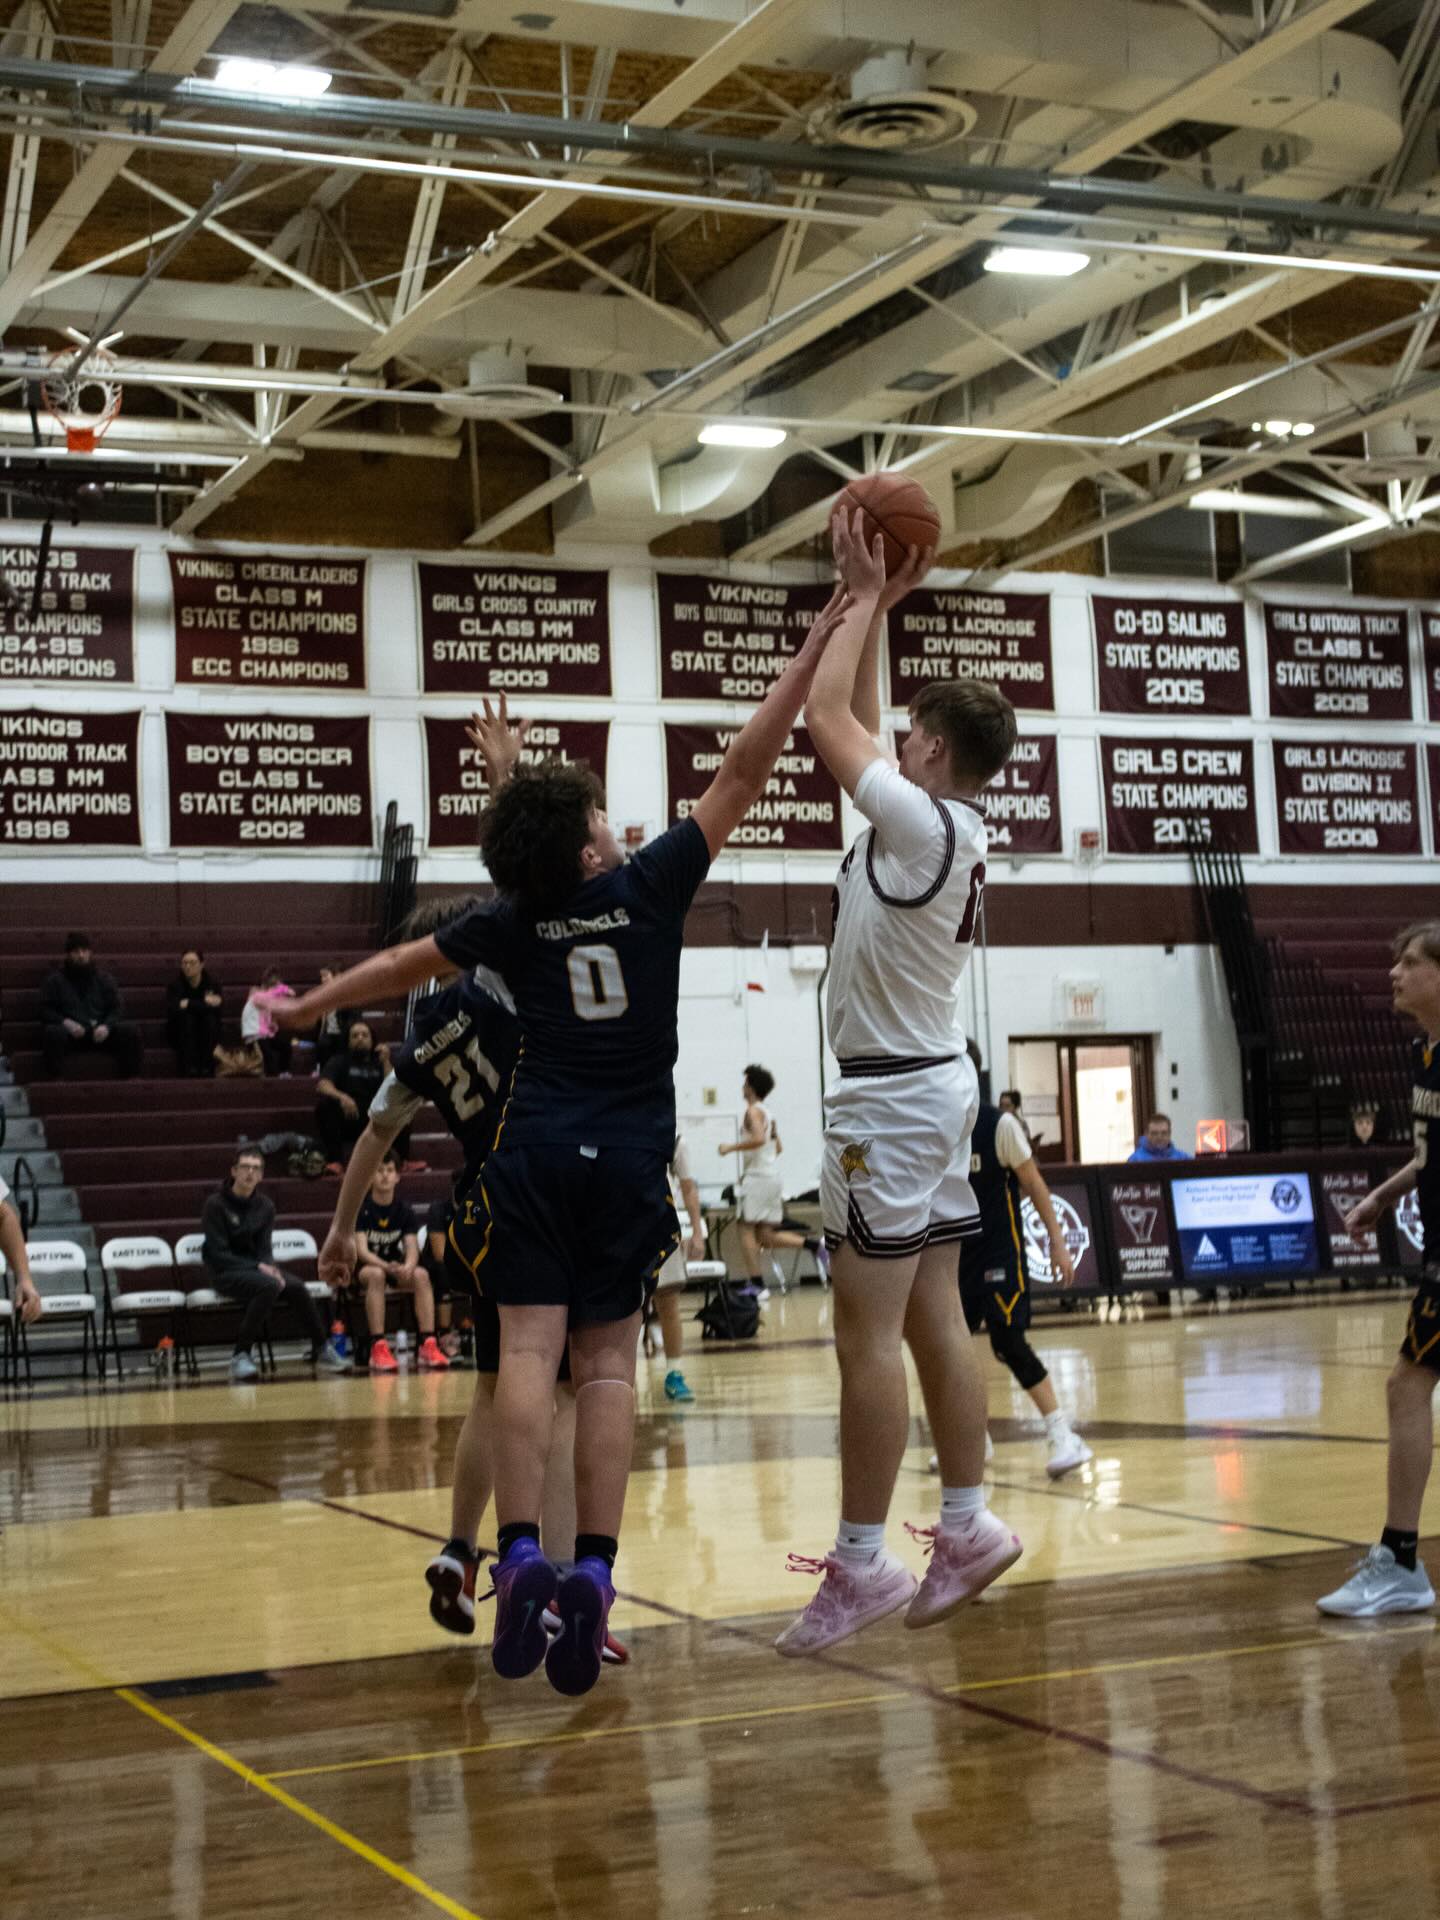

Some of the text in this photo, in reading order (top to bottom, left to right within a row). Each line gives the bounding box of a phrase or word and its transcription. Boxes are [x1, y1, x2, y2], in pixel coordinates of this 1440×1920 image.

[0, 549, 77, 569] KINGS
[59, 572, 111, 591] TRACK
[176, 560, 357, 585] VIKINGS CHEERLEADERS
[474, 574, 557, 593] VIKINGS
[215, 585, 323, 607] CLASS M
[708, 584, 789, 605] VIKINGS
[934, 596, 1005, 614] VIKINGS
[432, 595, 597, 616] GIRLS CROSS COUNTRY
[674, 604, 700, 621] BOYS
[705, 605, 748, 624] OUTDOOR
[752, 609, 784, 627] TRACK
[181, 608, 357, 634] STATE CHAMPIONS
[460, 618, 573, 638] CLASS MM
[904, 615, 1036, 637] BOYS LACROSSE
[1114, 609, 1226, 637] CO-ED SAILING
[1273, 611, 1400, 635] GIRLS OUTDOOR TRACK
[0, 636, 84, 655] 94-95
[703, 631, 795, 652] CLASS L
[924, 637, 1019, 657] DIVISION II
[1294, 638, 1383, 659] CLASS L
[433, 641, 600, 664] STATE CHAMPIONS
[671, 651, 792, 675] STATE CHAMP
[1106, 643, 1240, 671] STATE CHAMPIONS
[1, 657, 116, 677] CHAMPIONS
[192, 658, 349, 681] ECC CHAMPIONS
[900, 658, 1044, 681] STATE CHAMPIONS
[1276, 661, 1403, 688] STATE CHAMPIONS
[489, 669, 549, 687] 2003
[1147, 679, 1204, 704] 2005
[0, 717, 83, 737] IKINGS
[224, 722, 315, 742] VIKINGS
[75, 744, 128, 762] TRACK
[186, 745, 352, 766] BOYS SOCCER
[1009, 743, 1040, 762] ACK
[1113, 748, 1242, 775] GIRLS CREW
[1285, 748, 1405, 769] GIRLS LACROSSE
[774, 756, 815, 773] REW
[0, 768, 104, 786] ASS MM
[218, 769, 323, 789] CLASS L
[1013, 768, 1029, 788] L
[1302, 773, 1392, 793] DIVISION II
[13, 792, 131, 815] CHAMPIONS
[179, 792, 362, 816] STATE CHAMPIONS
[978, 794, 1050, 820] AMPIONS
[1112, 783, 1248, 810] STATE CHAMPIONS
[1285, 798, 1411, 823] STATE CHAMPIONS
[240, 821, 305, 840] 2002
[986, 825, 1012, 845] 04
[536, 908, 630, 940] COLONELS
[567, 944, 628, 1021] 0
